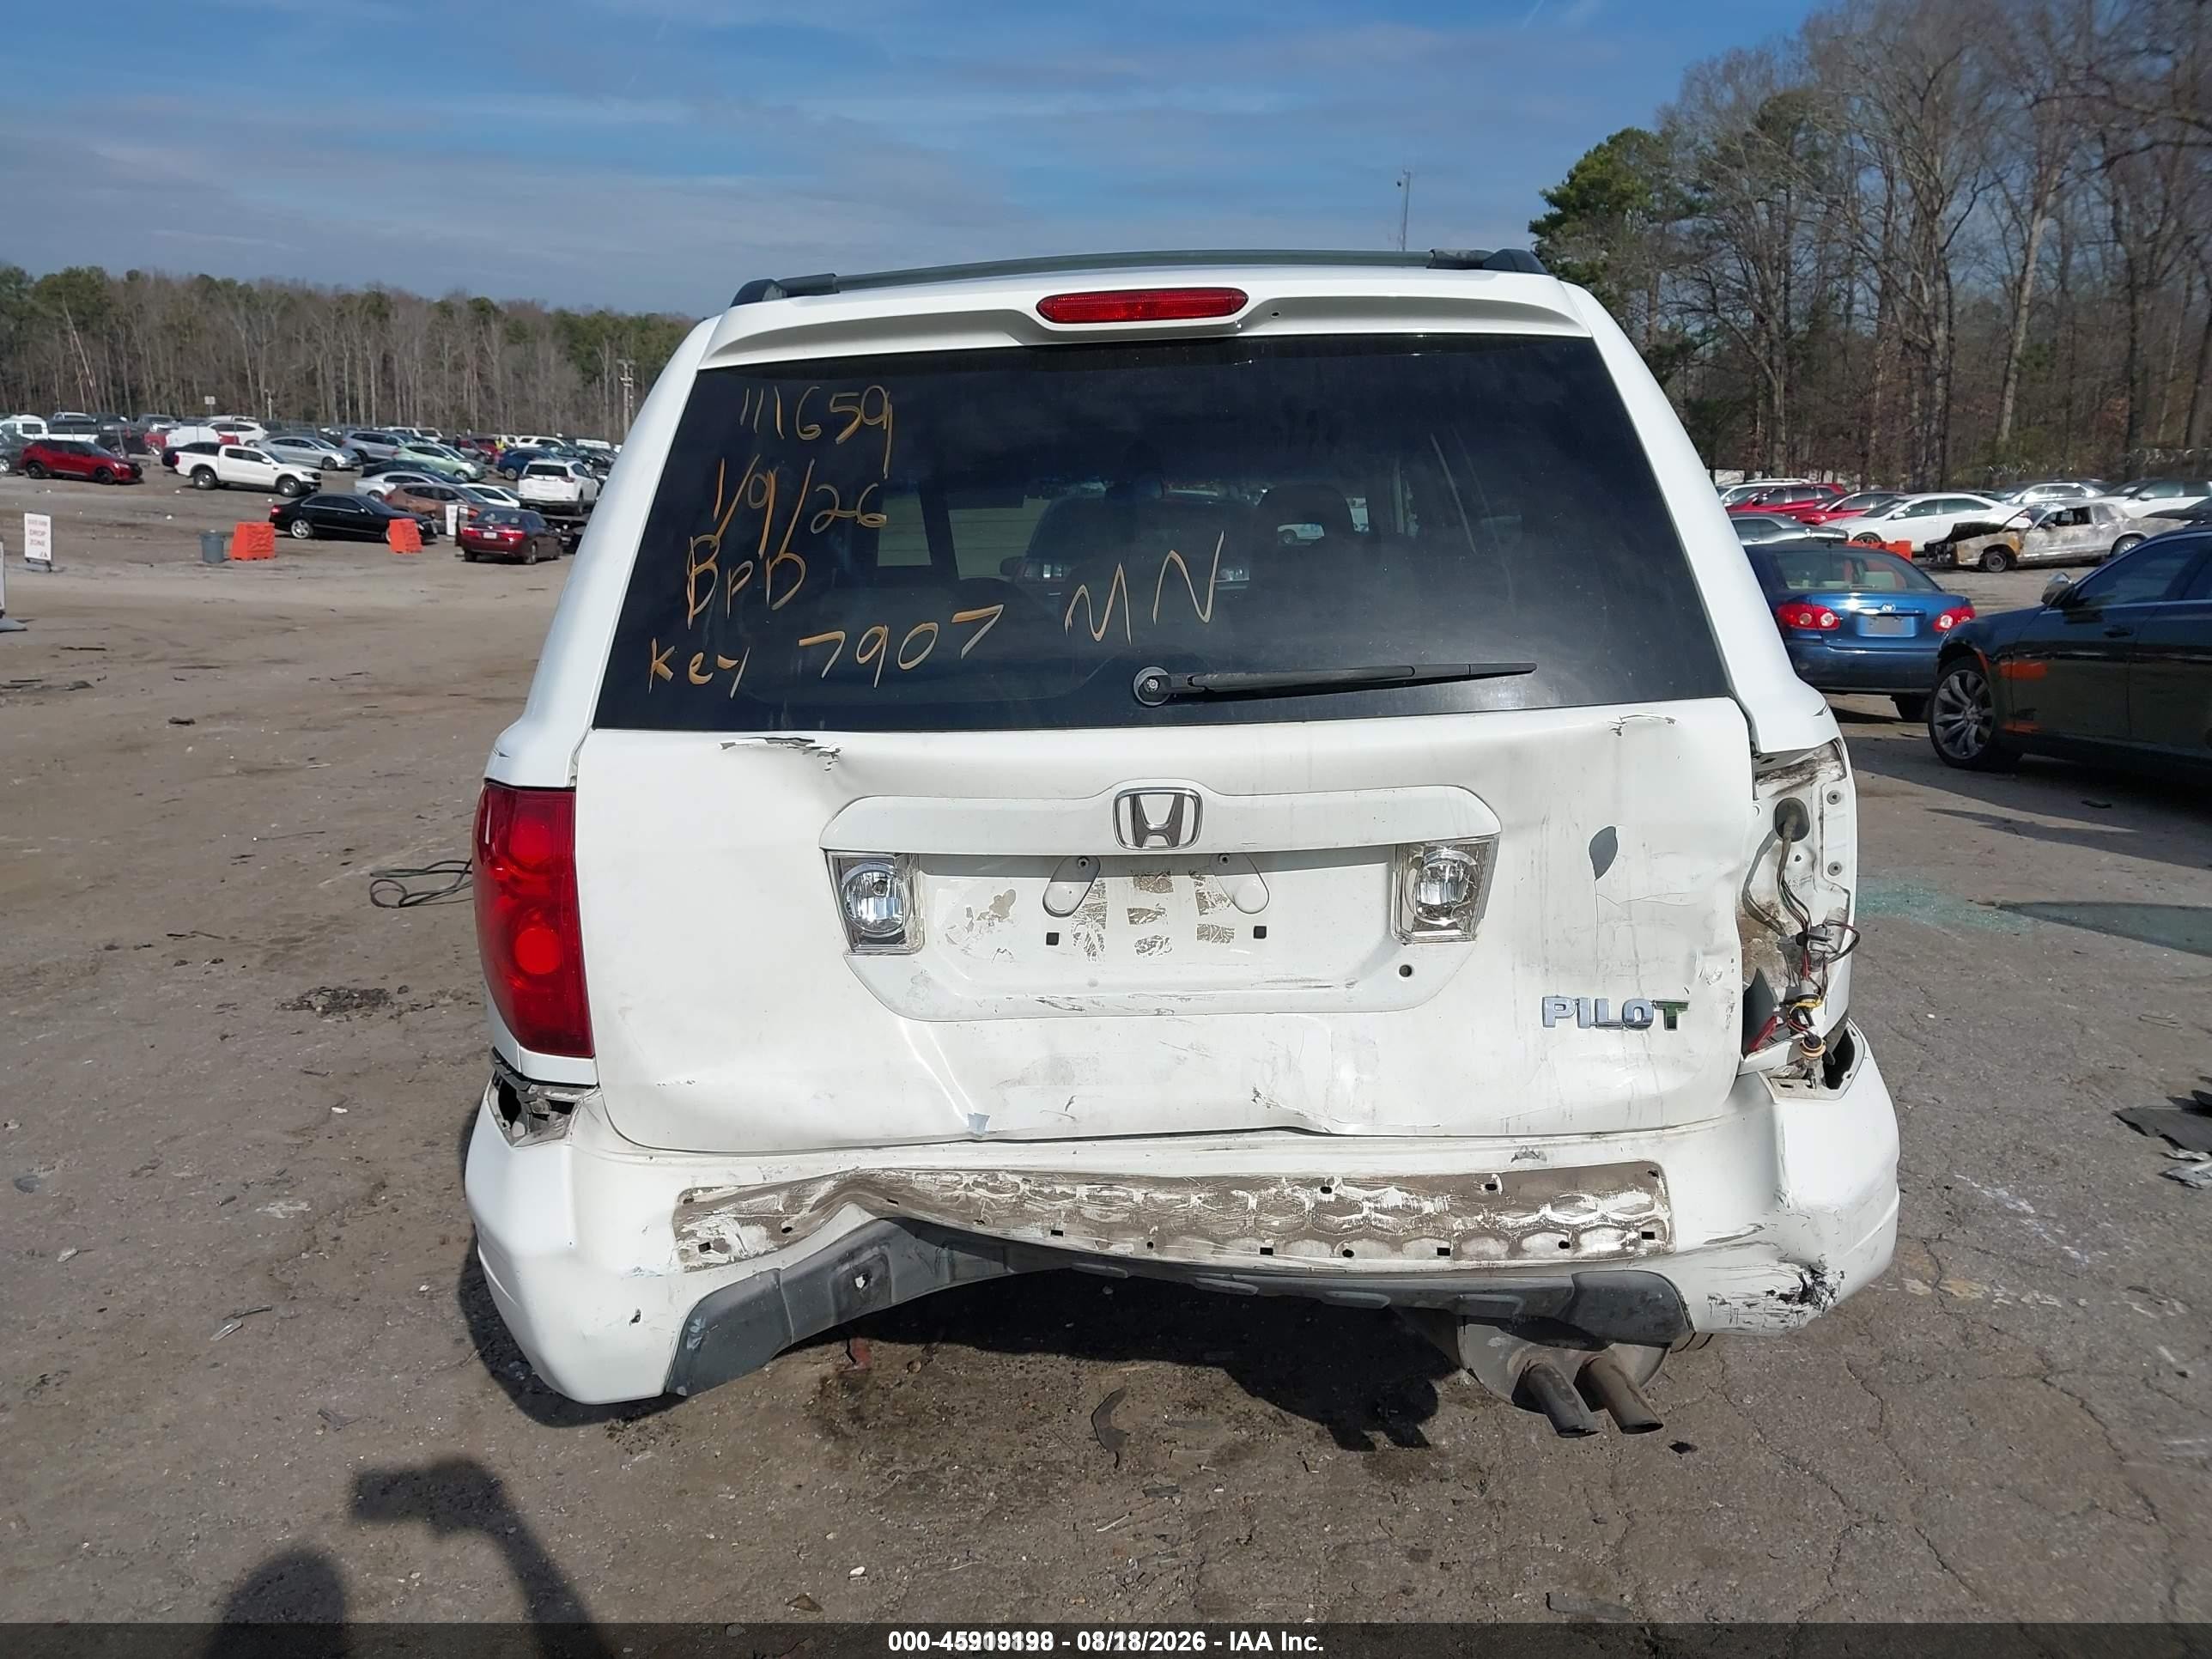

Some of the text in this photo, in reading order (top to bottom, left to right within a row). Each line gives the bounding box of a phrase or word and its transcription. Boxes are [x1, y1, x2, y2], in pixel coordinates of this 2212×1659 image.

[739, 385, 893, 479] 111659
[712, 454, 888, 563] 1/9/26
[799, 604, 1005, 689] 7907
[1542, 996, 1690, 1031] PILOT
